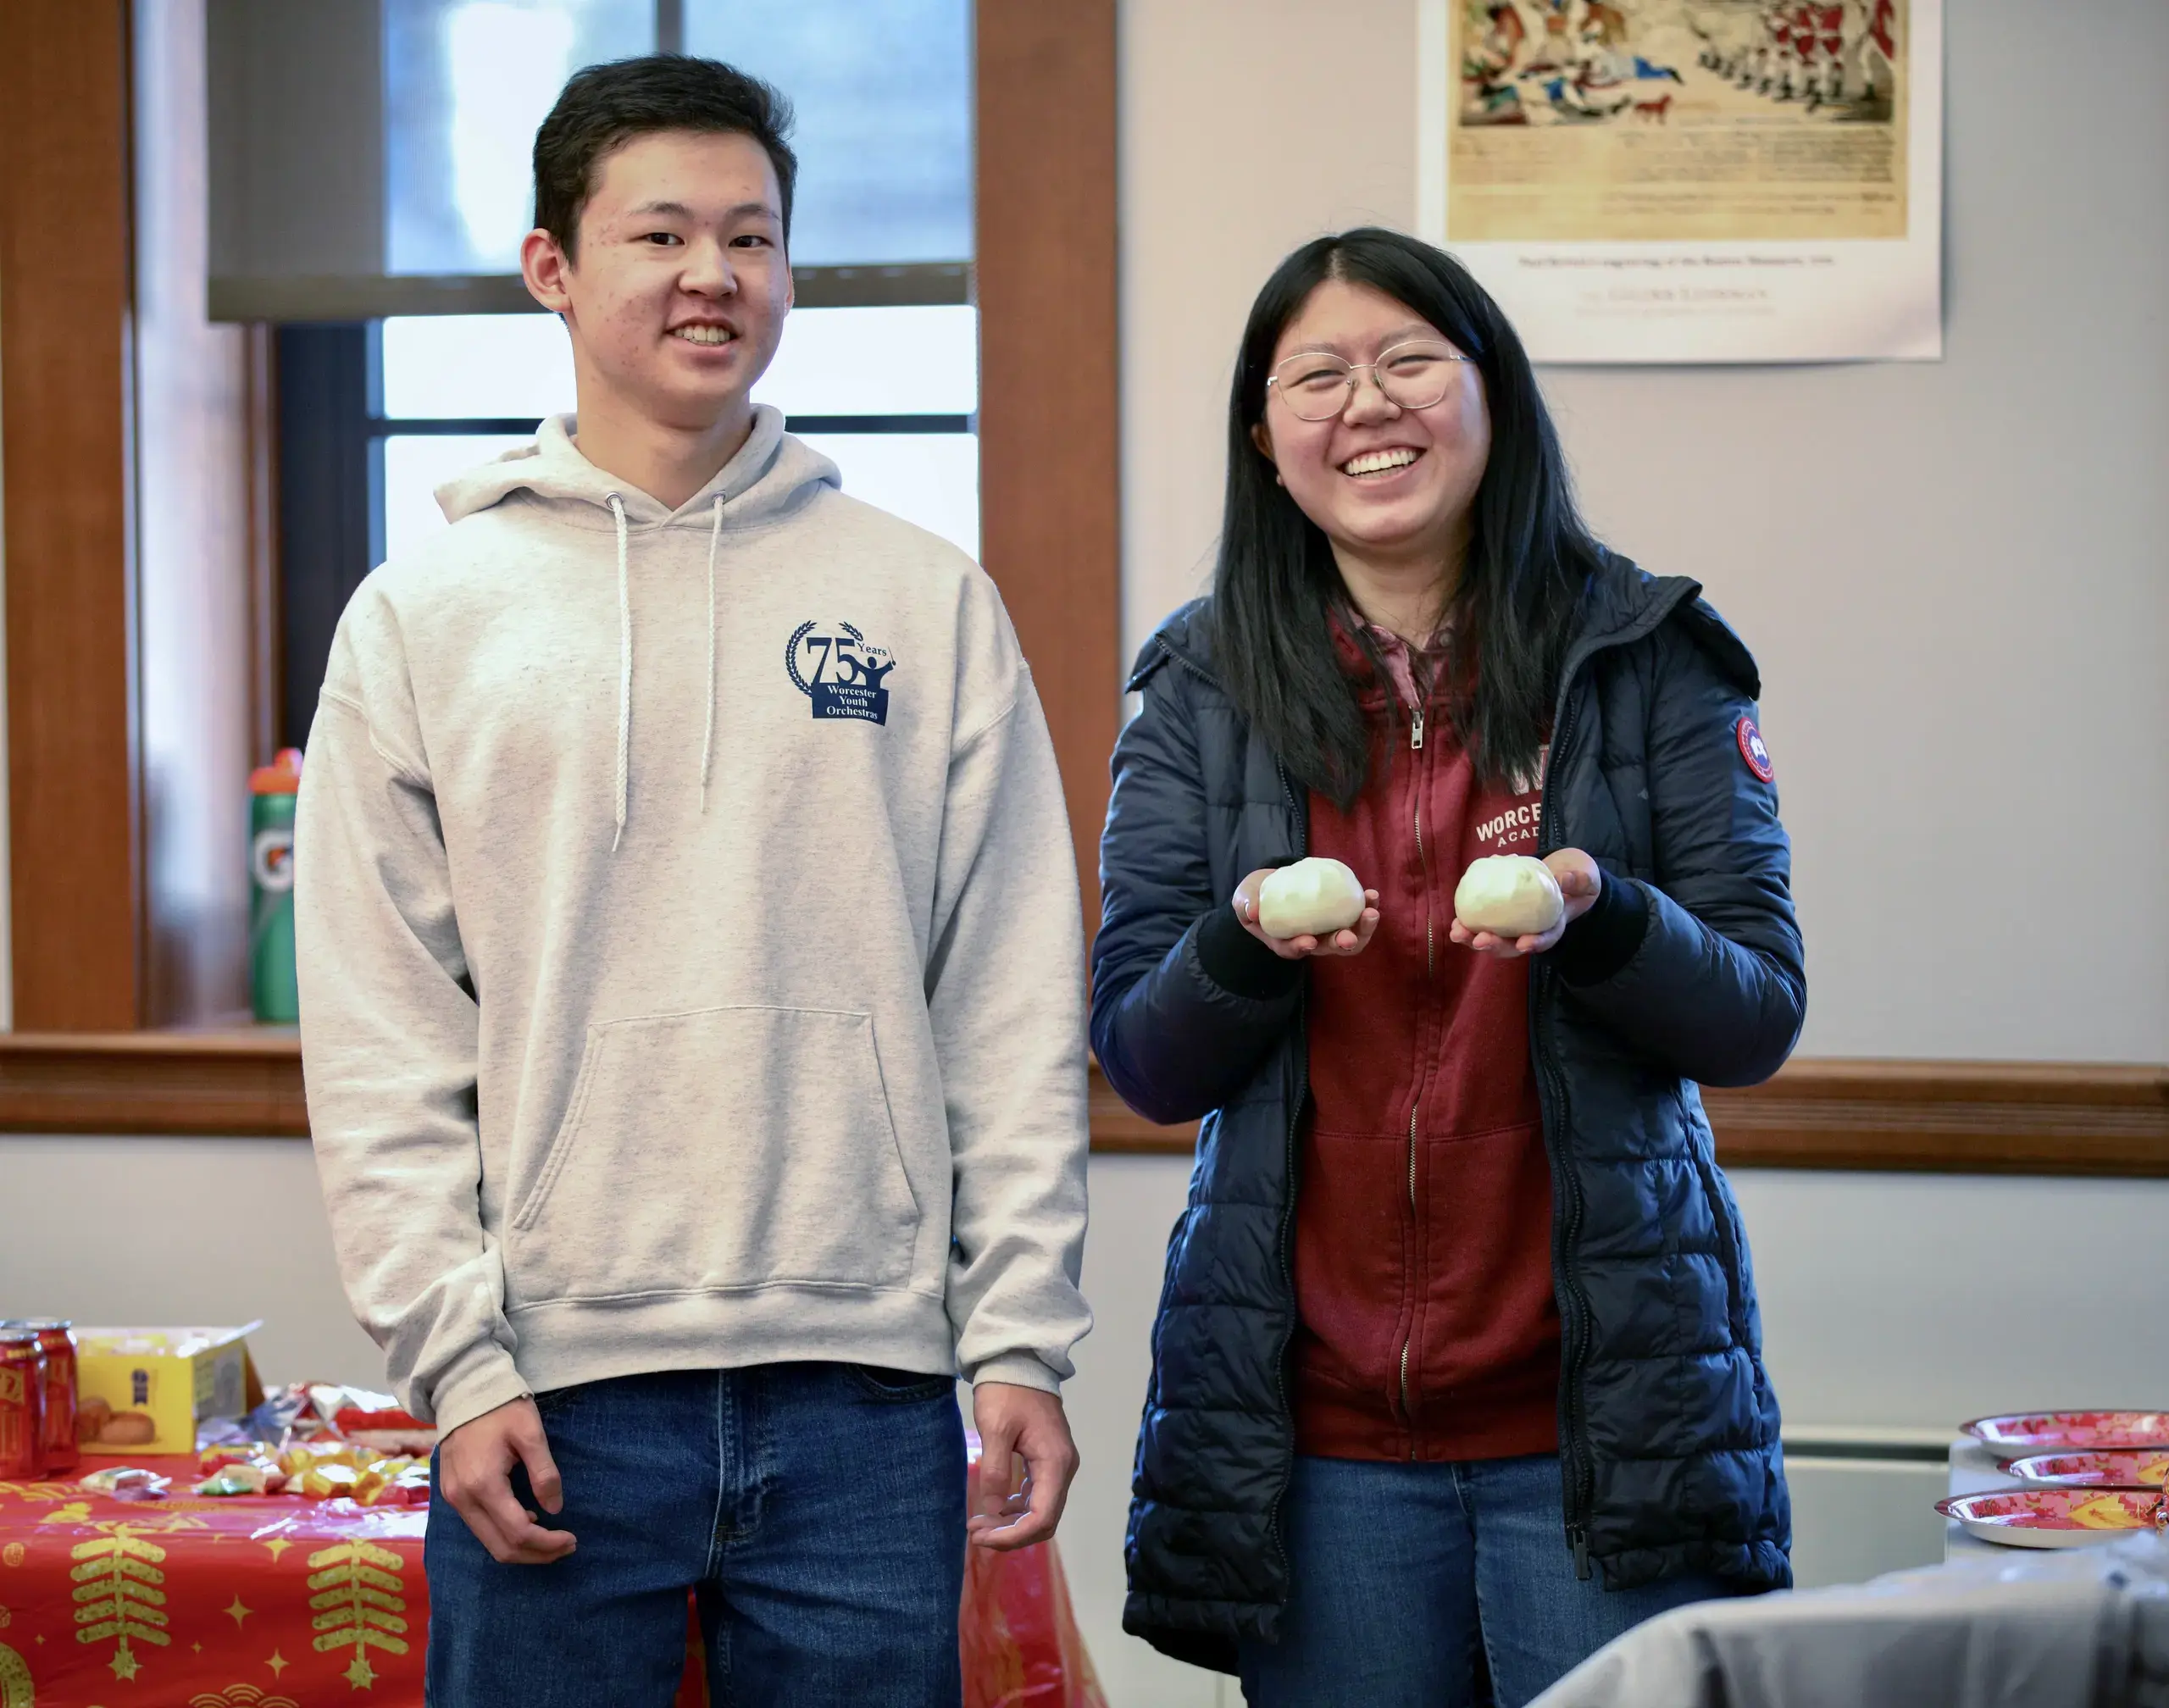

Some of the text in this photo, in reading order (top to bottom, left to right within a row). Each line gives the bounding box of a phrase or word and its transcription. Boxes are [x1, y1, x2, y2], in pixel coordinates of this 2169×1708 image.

[856, 642, 887, 657] Years
[806, 637, 858, 685] 75
[827, 685, 877, 699] Worcester
[839, 696, 868, 707] Youth
[826, 706, 878, 719] Orchestras
